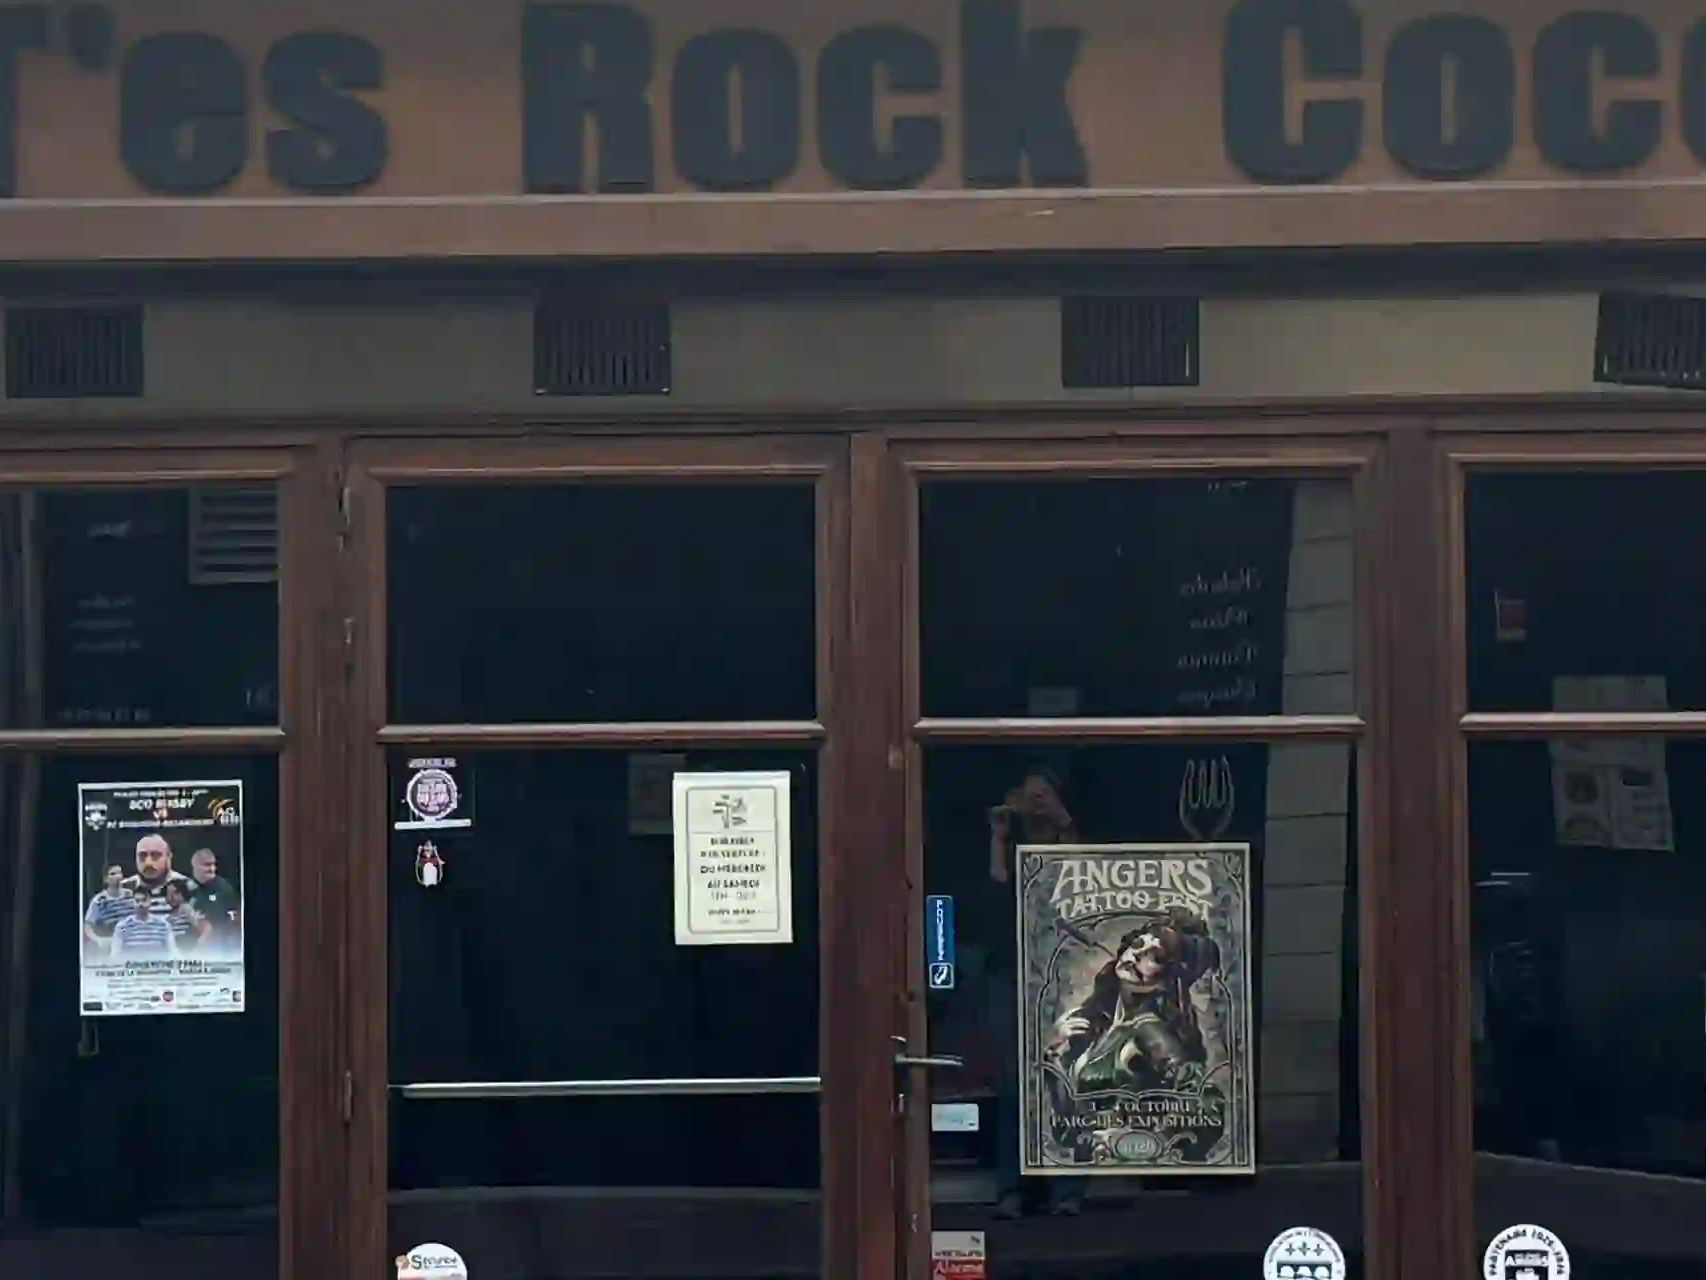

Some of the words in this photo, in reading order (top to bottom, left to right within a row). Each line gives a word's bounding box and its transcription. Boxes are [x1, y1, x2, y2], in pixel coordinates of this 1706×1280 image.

[1049, 858, 1213, 903] ANGERS
[1055, 890, 1155, 919] TATTOO
[1155, 891, 1213, 922] FEST
[1050, 1114, 1094, 1129] PARC
